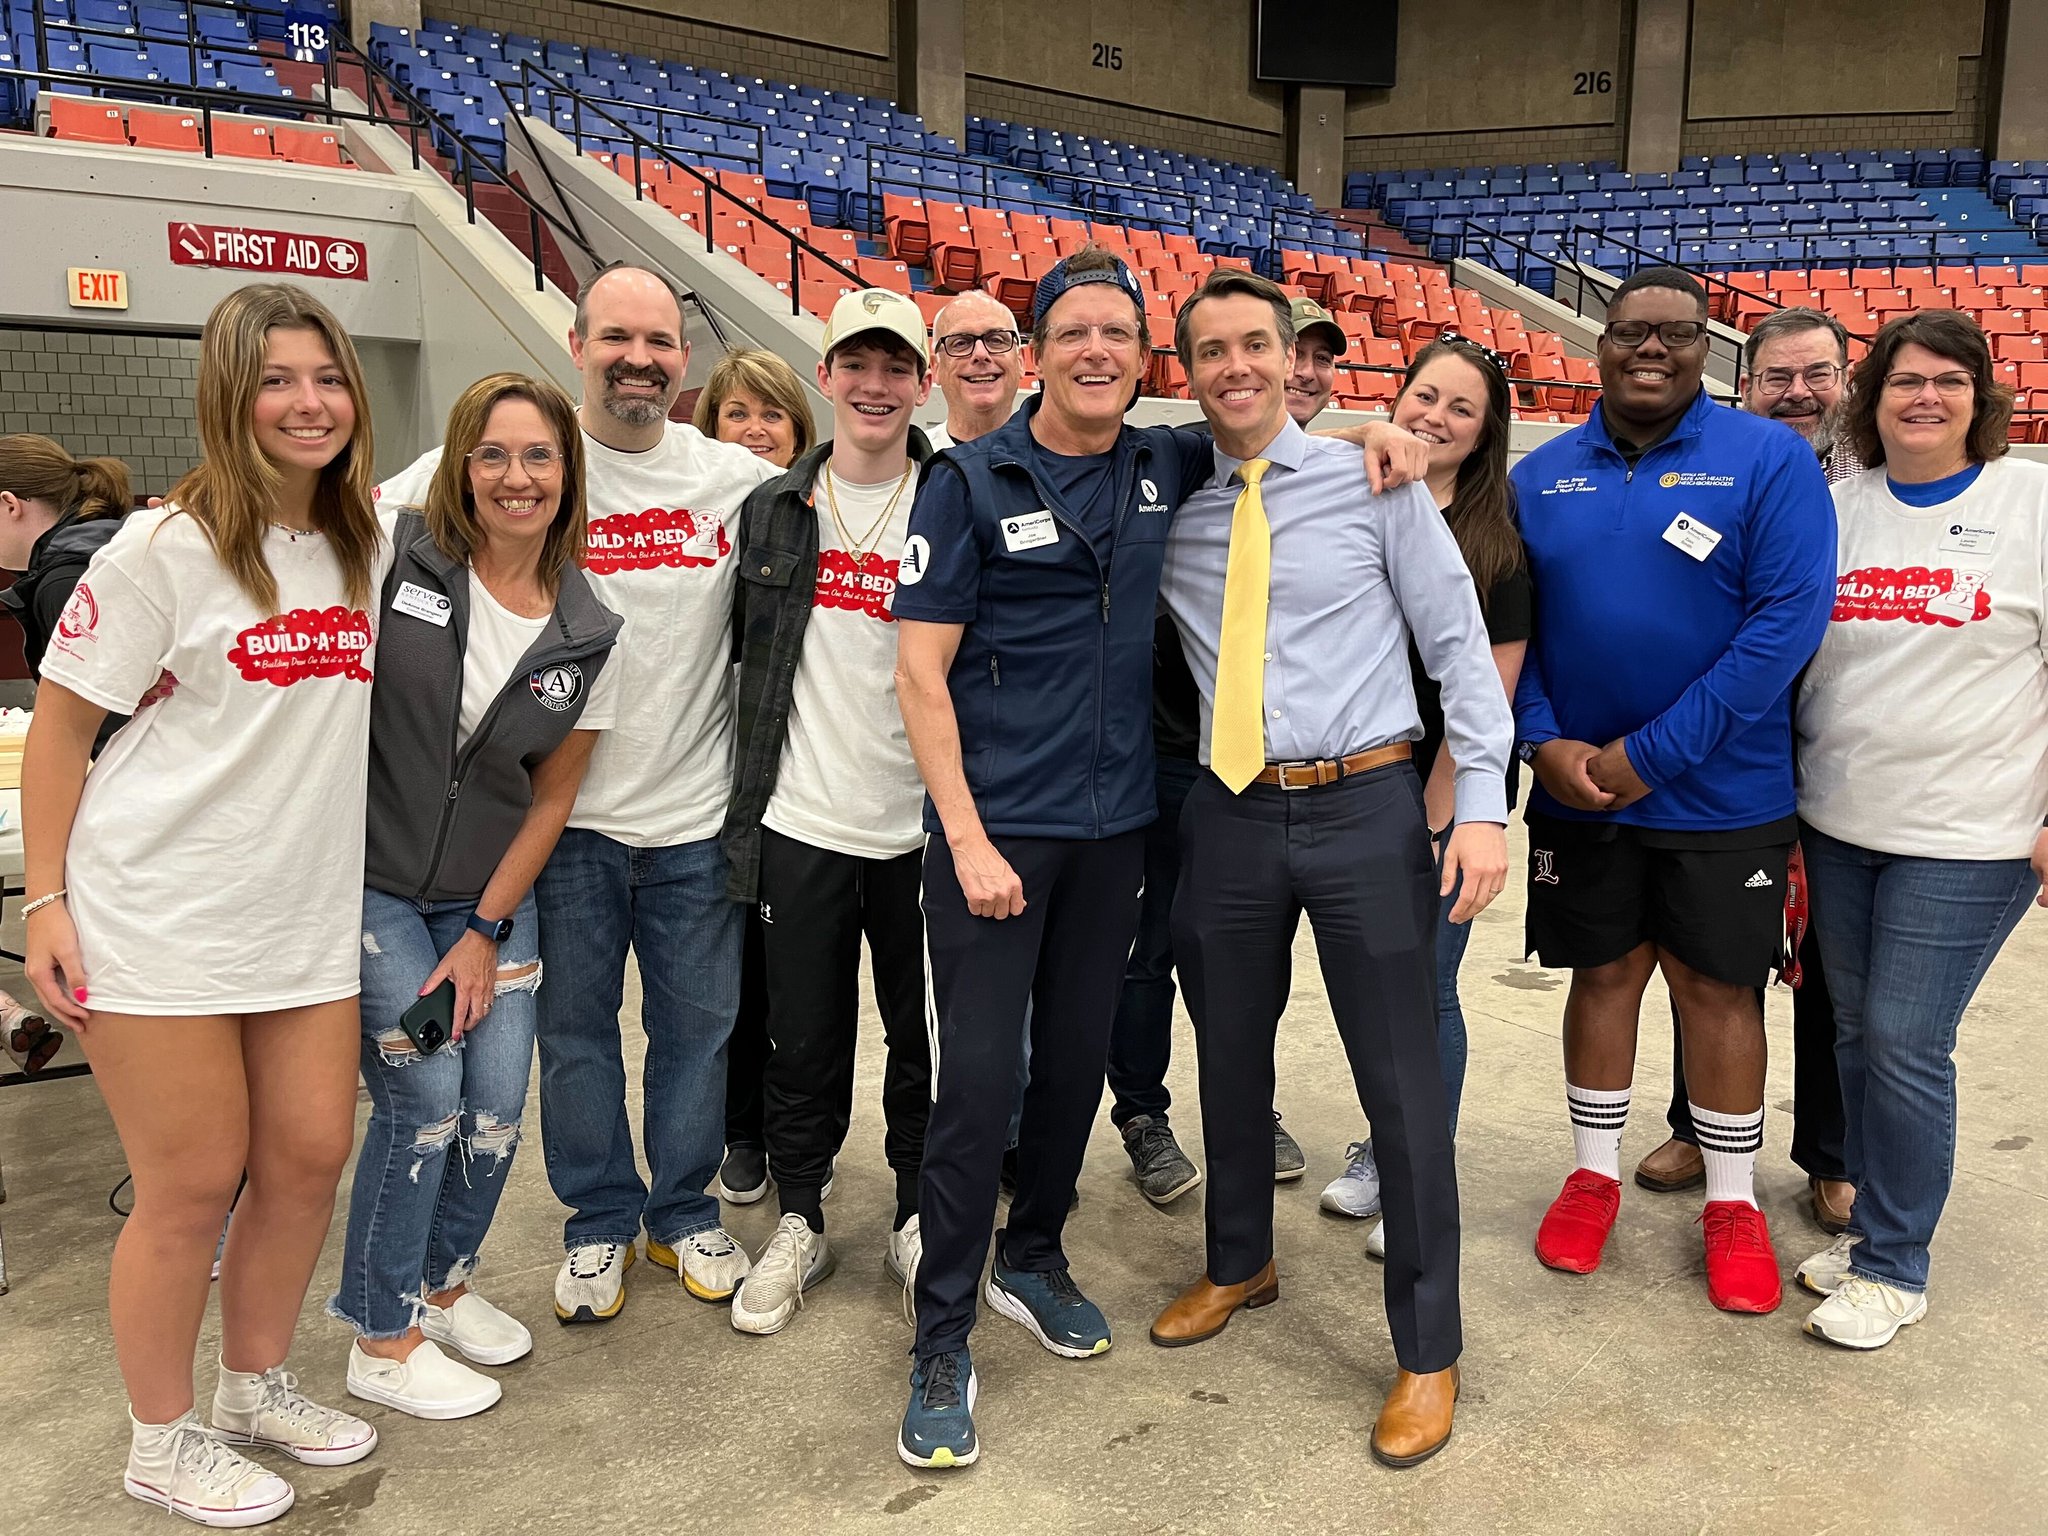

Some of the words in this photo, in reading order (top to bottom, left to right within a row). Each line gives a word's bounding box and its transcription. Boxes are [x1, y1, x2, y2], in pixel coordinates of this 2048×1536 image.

[288, 22, 325, 50] 113
[1092, 43, 1122, 70] 215
[1573, 71, 1611, 95] 216
[213, 232, 275, 266] FIRST
[285, 239, 320, 270] AID
[78, 272, 118, 302] EXIT
[1138, 504, 1168, 513] AmeriCorp
[588, 533, 625, 548] UILD
[634, 532, 647, 548] A
[653, 529, 688, 545] BED
[404, 586, 437, 601] serve
[862, 572, 896, 593] BED
[1836, 583, 1874, 598] UILD
[1881, 585, 1895, 600] A
[1903, 585, 1940, 599] BED
[246, 632, 310, 655] BUILD
[317, 632, 329, 651] A
[337, 631, 368, 650] BED
[548, 670, 567, 693] A
[540, 695, 570, 710] KENTUCKY
[1534, 849, 1559, 885] L
[1745, 879, 1773, 887] adidas
